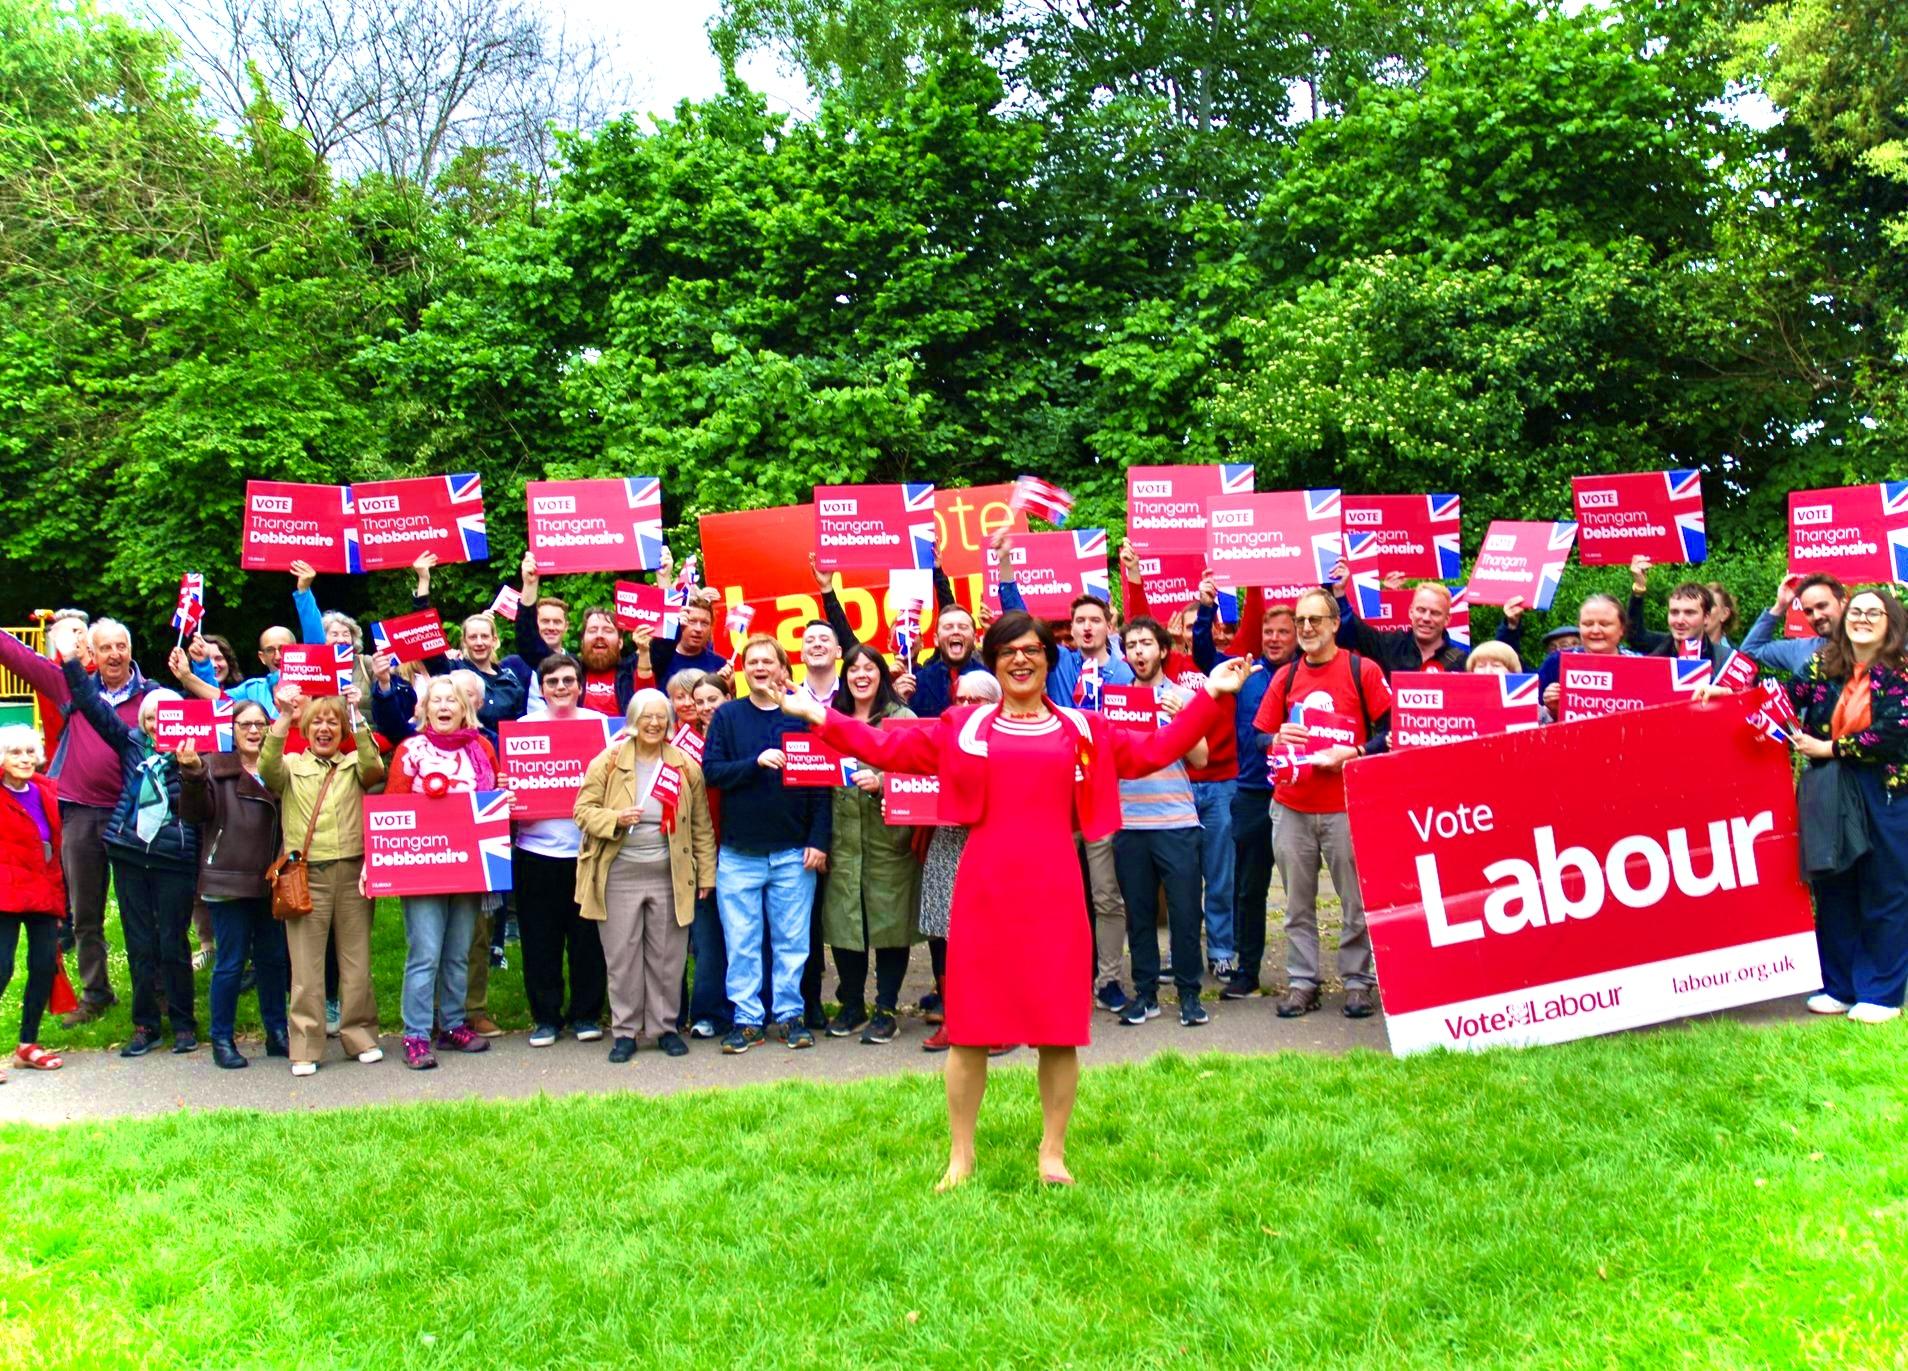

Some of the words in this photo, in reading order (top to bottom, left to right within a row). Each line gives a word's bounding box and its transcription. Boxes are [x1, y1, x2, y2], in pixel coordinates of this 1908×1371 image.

[1137, 485, 1168, 493] VOTE
[256, 499, 289, 510] VOTE
[362, 500, 396, 511] VOTE
[538, 500, 571, 510] VOTE
[1582, 494, 1614, 504] VOTE
[823, 503, 852, 512] VOTE
[1134, 501, 1199, 516] Thangam
[1797, 509, 1828, 520] VOTE
[251, 516, 318, 532] Thangam
[361, 514, 430, 530] Thangam
[1132, 514, 1208, 529] Debbonair
[1216, 513, 1249, 523] VOTE
[1349, 512, 1378, 522] VOTE
[1581, 510, 1648, 527] Thangam
[535, 518, 606, 533] Thangam
[820, 518, 883, 534] Thangam
[1583, 524, 1666, 541] Debbonaire
[250, 531, 334, 546] Debbonaire
[364, 526, 448, 545] Debbonaire
[536, 530, 624, 548] Debbonaire
[820, 532, 900, 546] Debbonaire
[1212, 529, 1283, 548] Thangam
[1795, 526, 1860, 543] Thangam
[1212, 543, 1301, 560] Debbonaire
[1794, 540, 1878, 559] Debbonaire
[617, 602, 660, 622] Labour
[283, 664, 322, 673] Thangam
[1570, 674, 1608, 686] VOTE
[1402, 694, 1439, 704] VOTE
[1566, 693, 1644, 714] Thangam
[1104, 707, 1152, 722] Labour
[159, 722, 212, 736] Labour
[1398, 713, 1476, 732] Thangam
[510, 740, 545, 751] VOTE
[786, 753, 826, 764] Thangam
[786, 762, 836, 770] Debbonaire
[508, 758, 582, 775] Thangam
[374, 814, 411, 826] VOTE
[1408, 804, 1494, 844] Vote
[372, 833, 448, 850] Thangam
[372, 848, 468, 867] Debbonaire
[1414, 810, 1774, 948] Labour
[1672, 954, 1796, 996] labour.org.uk
[1444, 1010, 1509, 1041] Vote
[1530, 985, 1624, 1024] Labour
